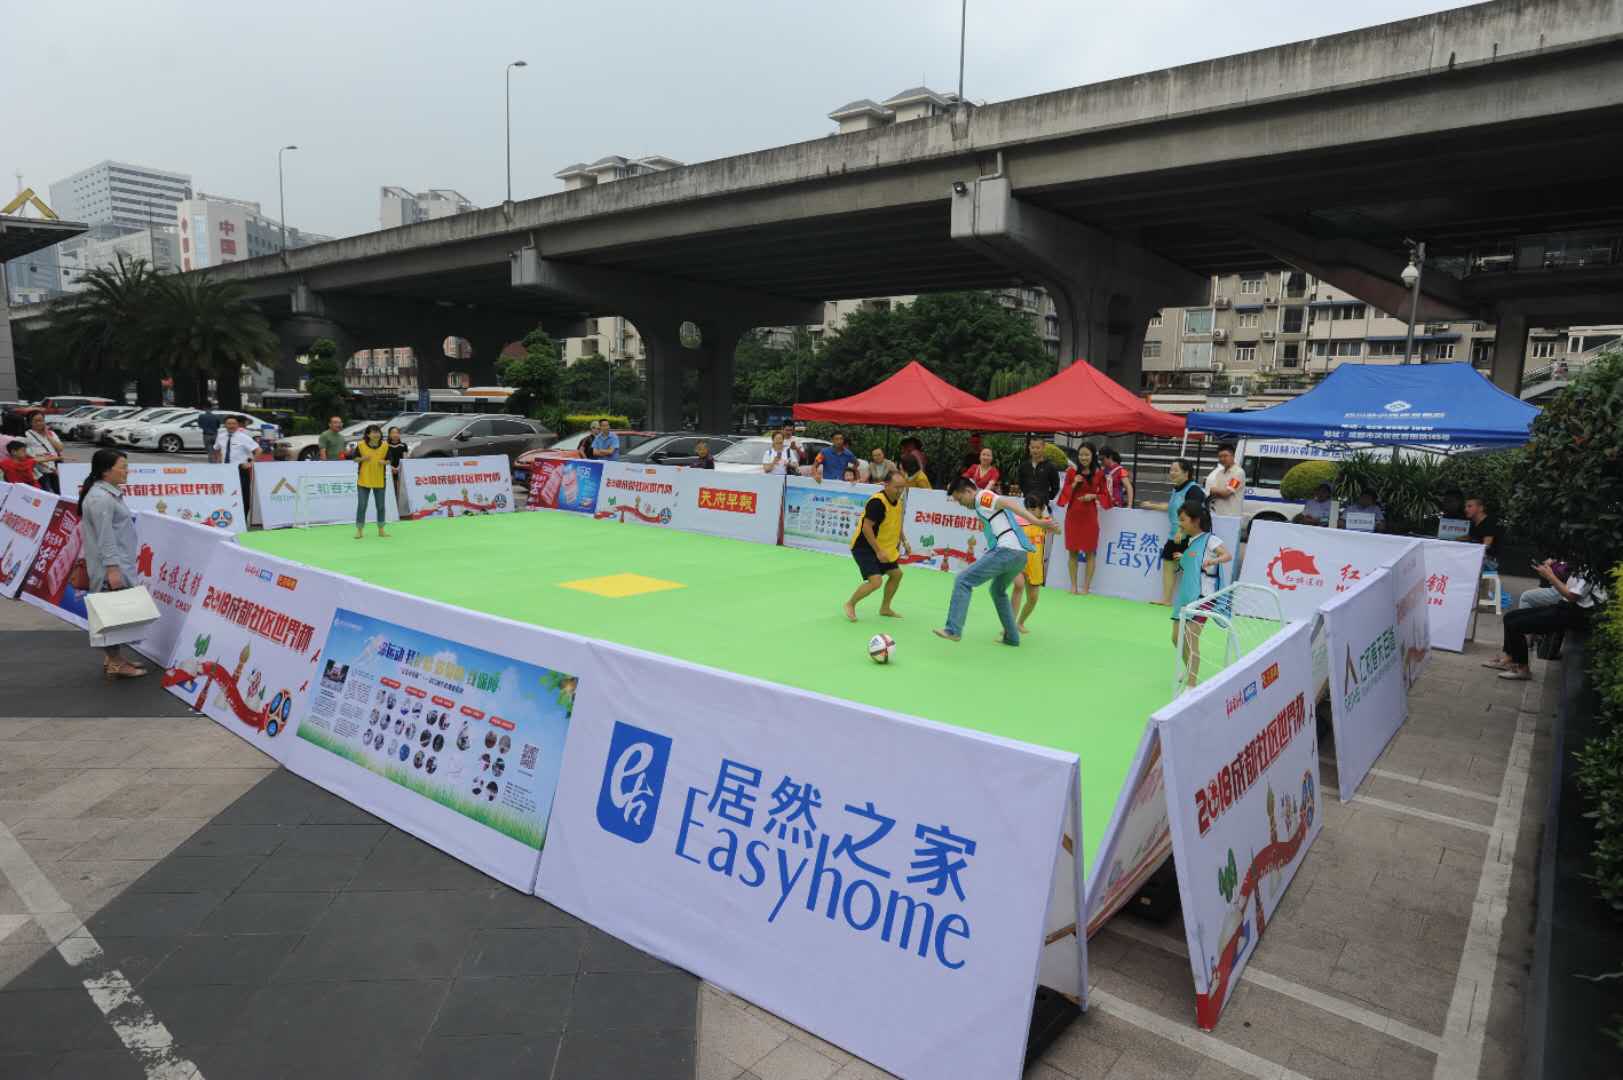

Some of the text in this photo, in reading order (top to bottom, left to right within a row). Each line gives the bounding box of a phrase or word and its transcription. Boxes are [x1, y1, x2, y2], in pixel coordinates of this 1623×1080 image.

[120, 484, 224, 497] 成都社区世界杯
[1117, 531, 1159, 553] 居然
[203, 585, 316, 653] 2018成都社区世界杯
[1194, 692, 1305, 835] 2018成都社区世界杯
[675, 786, 971, 970] Easyhome
[707, 758, 977, 901] 居然之家
